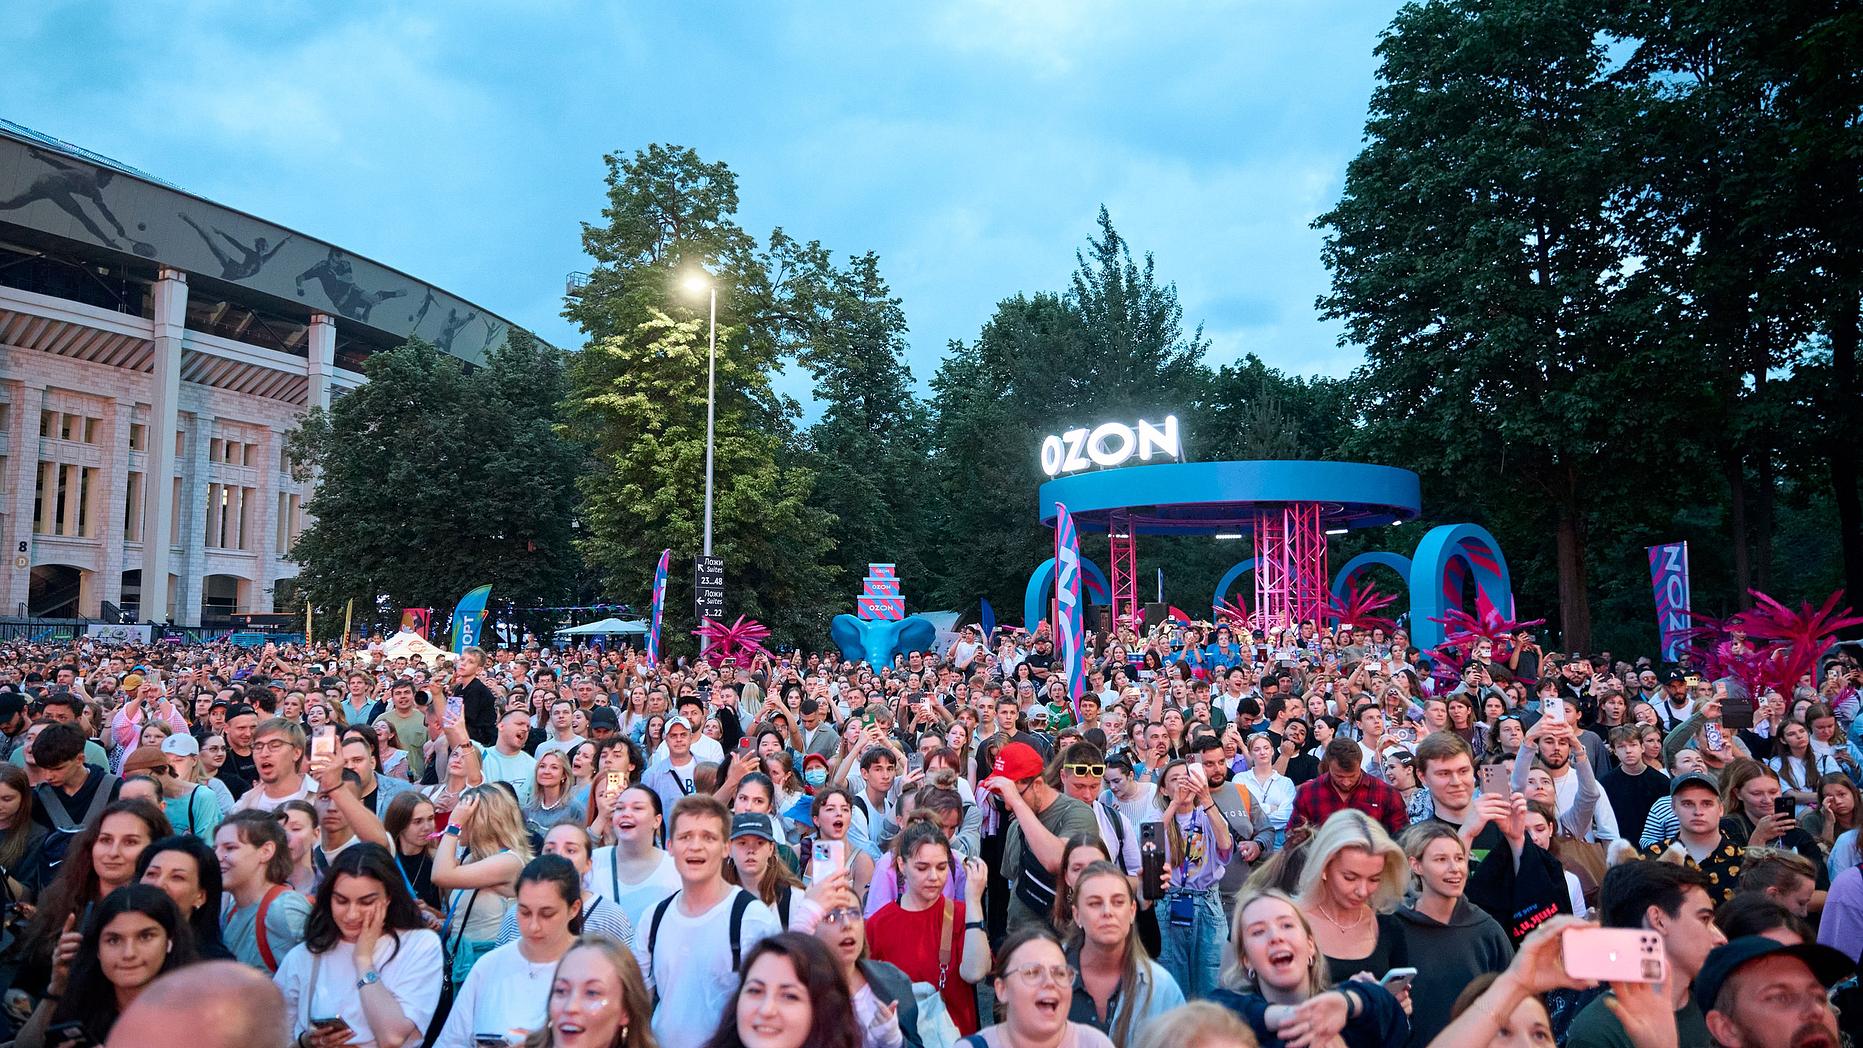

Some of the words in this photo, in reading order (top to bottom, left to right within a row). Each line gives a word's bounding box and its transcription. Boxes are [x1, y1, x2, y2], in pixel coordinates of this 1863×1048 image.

[1041, 415, 1179, 476] OZON
[18, 541, 28, 552] 8
[704, 558, 723, 566] Ложи
[704, 589, 723, 598] Ложи
[706, 597, 723, 605] Suites
